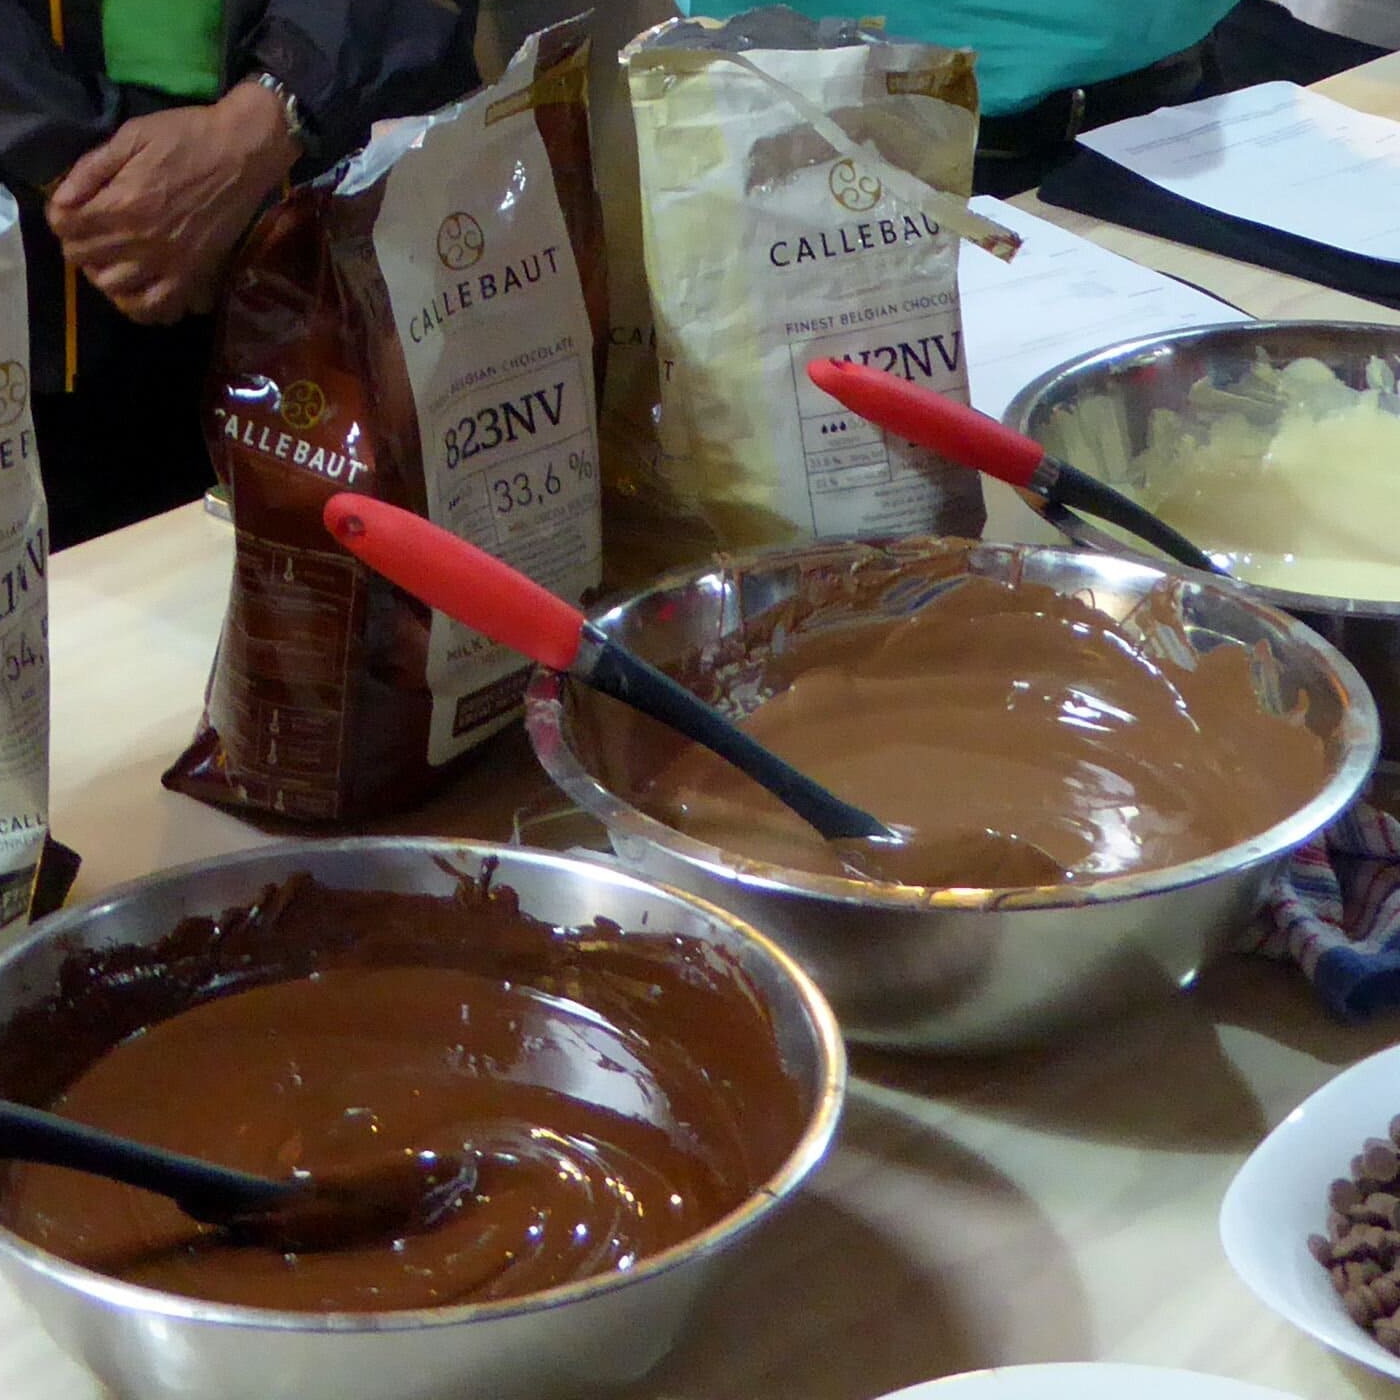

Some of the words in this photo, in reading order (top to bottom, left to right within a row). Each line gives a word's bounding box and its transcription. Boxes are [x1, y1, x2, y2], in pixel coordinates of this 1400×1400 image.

[770, 211, 941, 268] CALLEBAU
[410, 247, 560, 343] CALLEBAUT
[785, 315, 835, 337] FINEST
[839, 303, 899, 325] BELGIAN
[444, 382, 565, 470] 823NV
